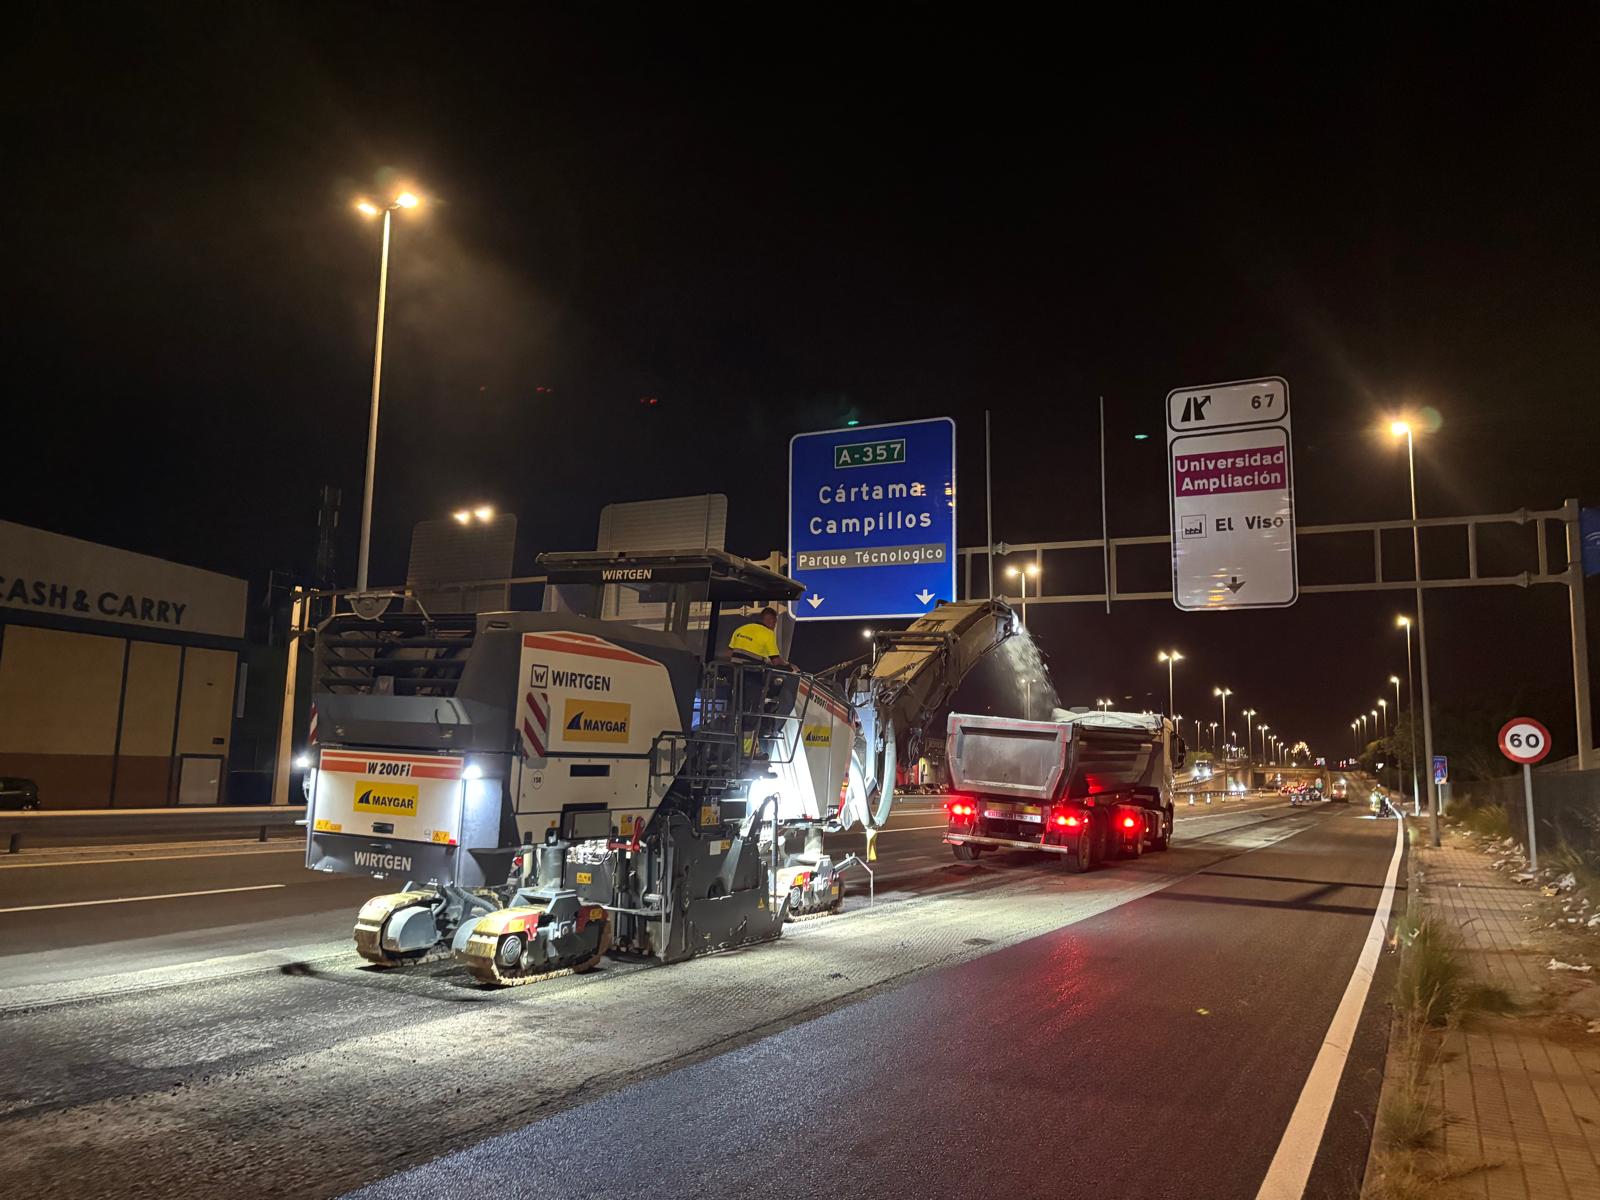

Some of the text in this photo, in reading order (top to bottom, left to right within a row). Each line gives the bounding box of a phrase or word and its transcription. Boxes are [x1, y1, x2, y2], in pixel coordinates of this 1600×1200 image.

[1251, 393, 1275, 409] 67
[838, 444, 902, 464] A-357
[1176, 450, 1284, 473] Universidad
[1181, 470, 1281, 492] Ampliación
[819, 482, 923, 504] Cártama
[809, 510, 932, 536] Campillos
[1215, 515, 1284, 532] El Viso
[799, 554, 848, 568] Parque
[601, 568, 653, 581] WIRTGEN
[0, 575, 187, 625] ASH & CARRY
[552, 669, 611, 692] WIRTGEN
[583, 718, 627, 734] MAYGAR
[1509, 733, 1540, 748] 60
[368, 761, 411, 777] W 200Fi
[372, 795, 414, 809] MAYGAR
[354, 850, 412, 871] WIRTGEN
